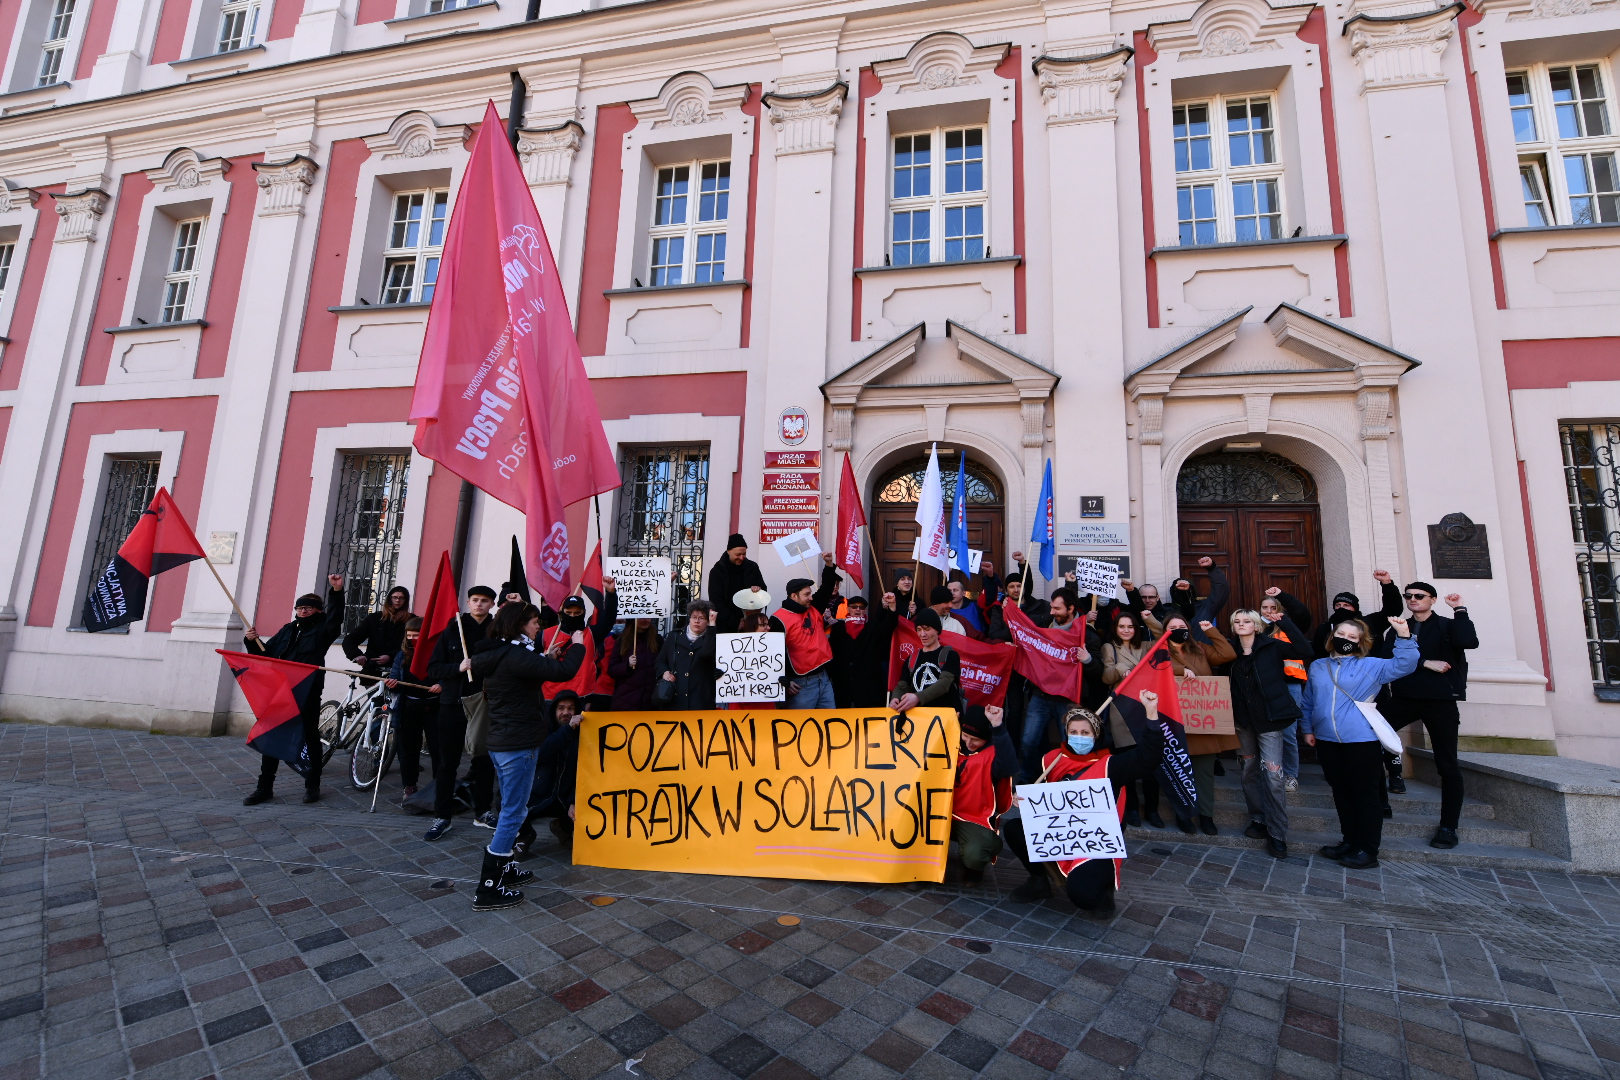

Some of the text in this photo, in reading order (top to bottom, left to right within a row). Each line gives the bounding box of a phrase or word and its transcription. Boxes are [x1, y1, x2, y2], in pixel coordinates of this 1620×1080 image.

[621, 559, 652, 568] DOŚĆ
[1078, 560, 1092, 568] KASA
[1090, 571, 1114, 580] TYLKO
[618, 600, 659, 608] OPRZEĆ
[731, 632, 767, 653] DZIŚ
[718, 653, 783, 673] SOLARIS
[724, 672, 768, 684] JUTRO
[976, 670, 1002, 686] Pracy
[719, 684, 745, 697] CAŁY
[598, 713, 952, 772] POZNAŃ POPIERA
[1028, 786, 1111, 814] MUREM
[586, 776, 953, 849] STRAJK W SOLARISIE
[1047, 815, 1088, 828] ZA
[1031, 827, 1112, 845] ZAŁOGĄ
[1035, 836, 1124, 857] SOLARIS!
